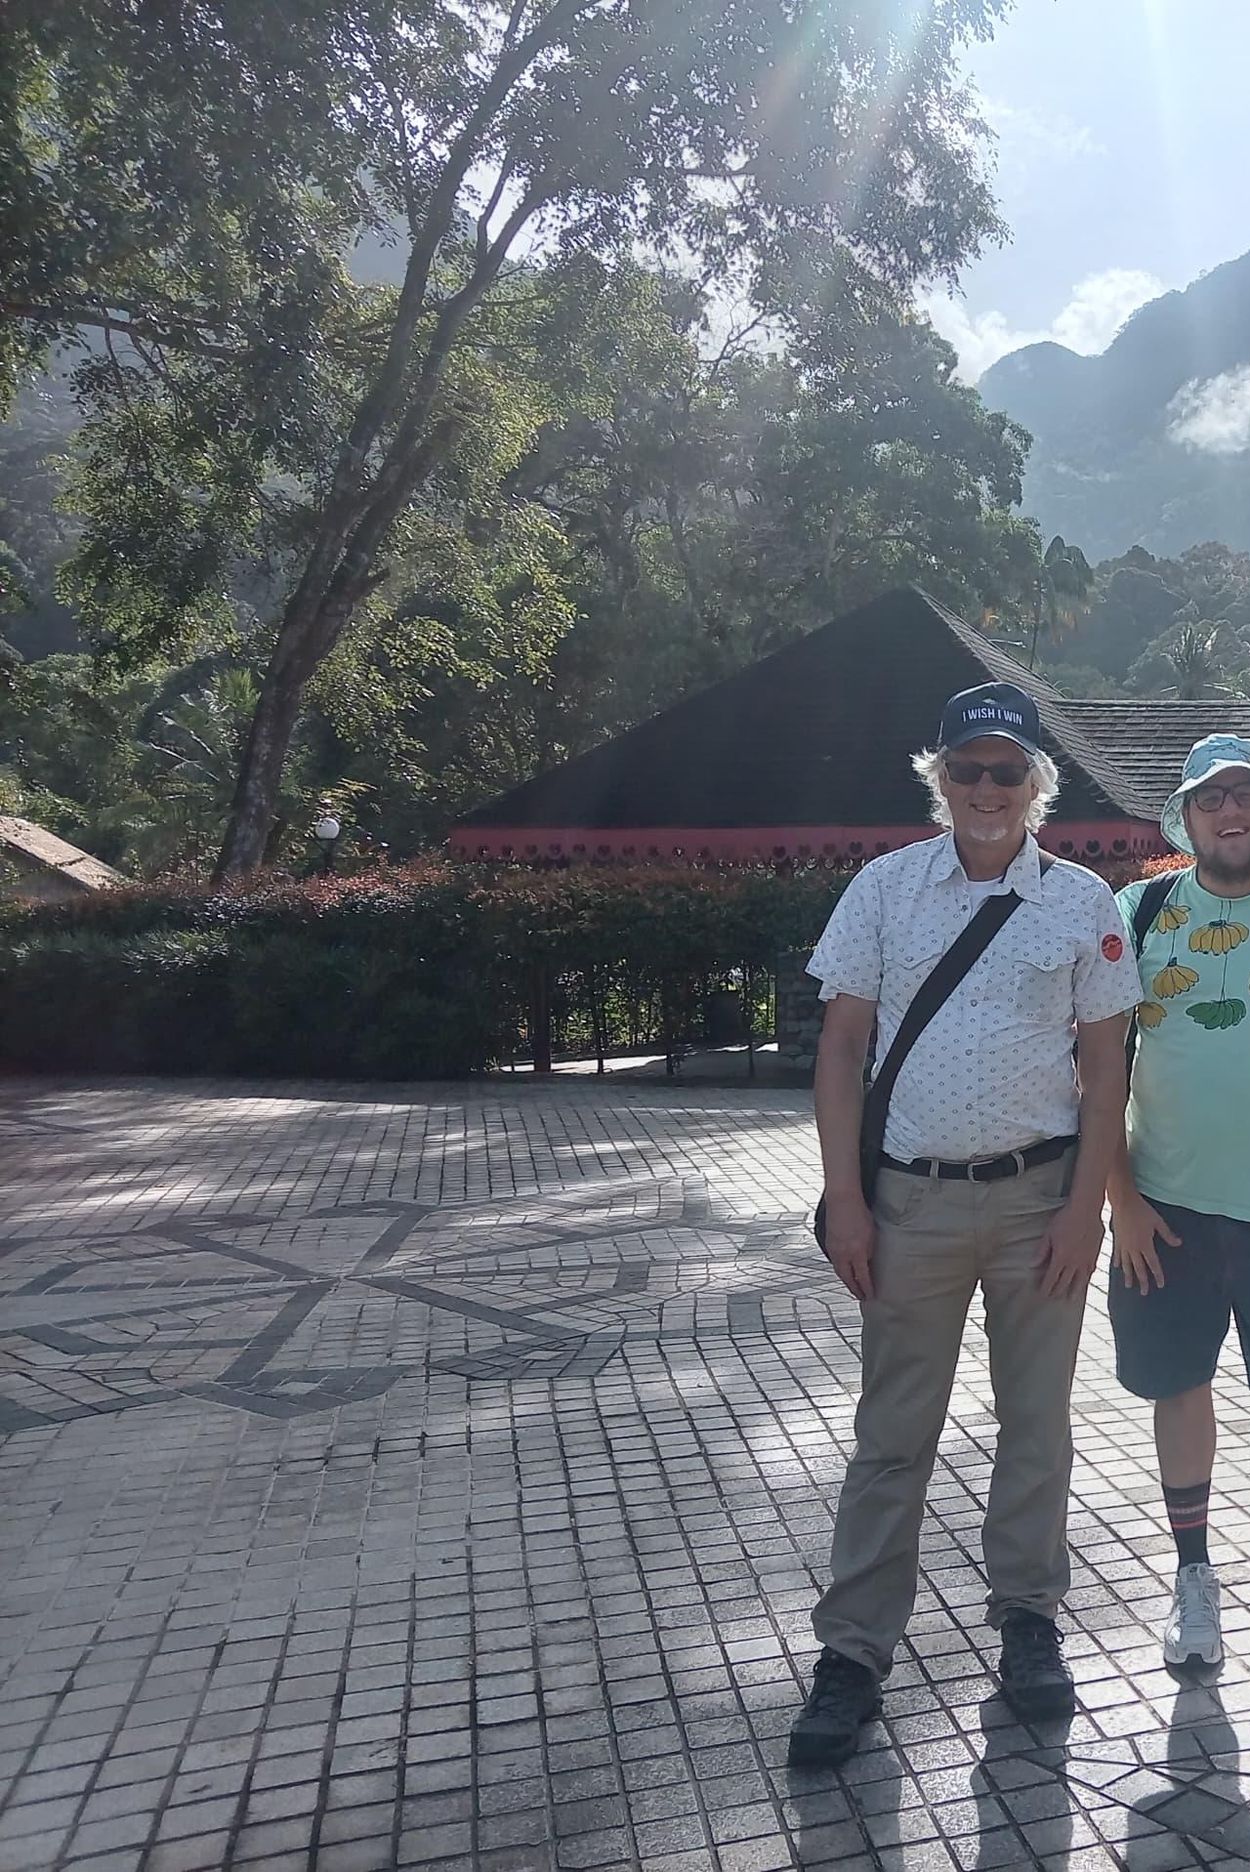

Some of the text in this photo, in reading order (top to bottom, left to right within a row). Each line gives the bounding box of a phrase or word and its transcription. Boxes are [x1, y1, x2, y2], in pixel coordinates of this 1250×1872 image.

[962, 707, 1023, 726] I WISH I WIN
